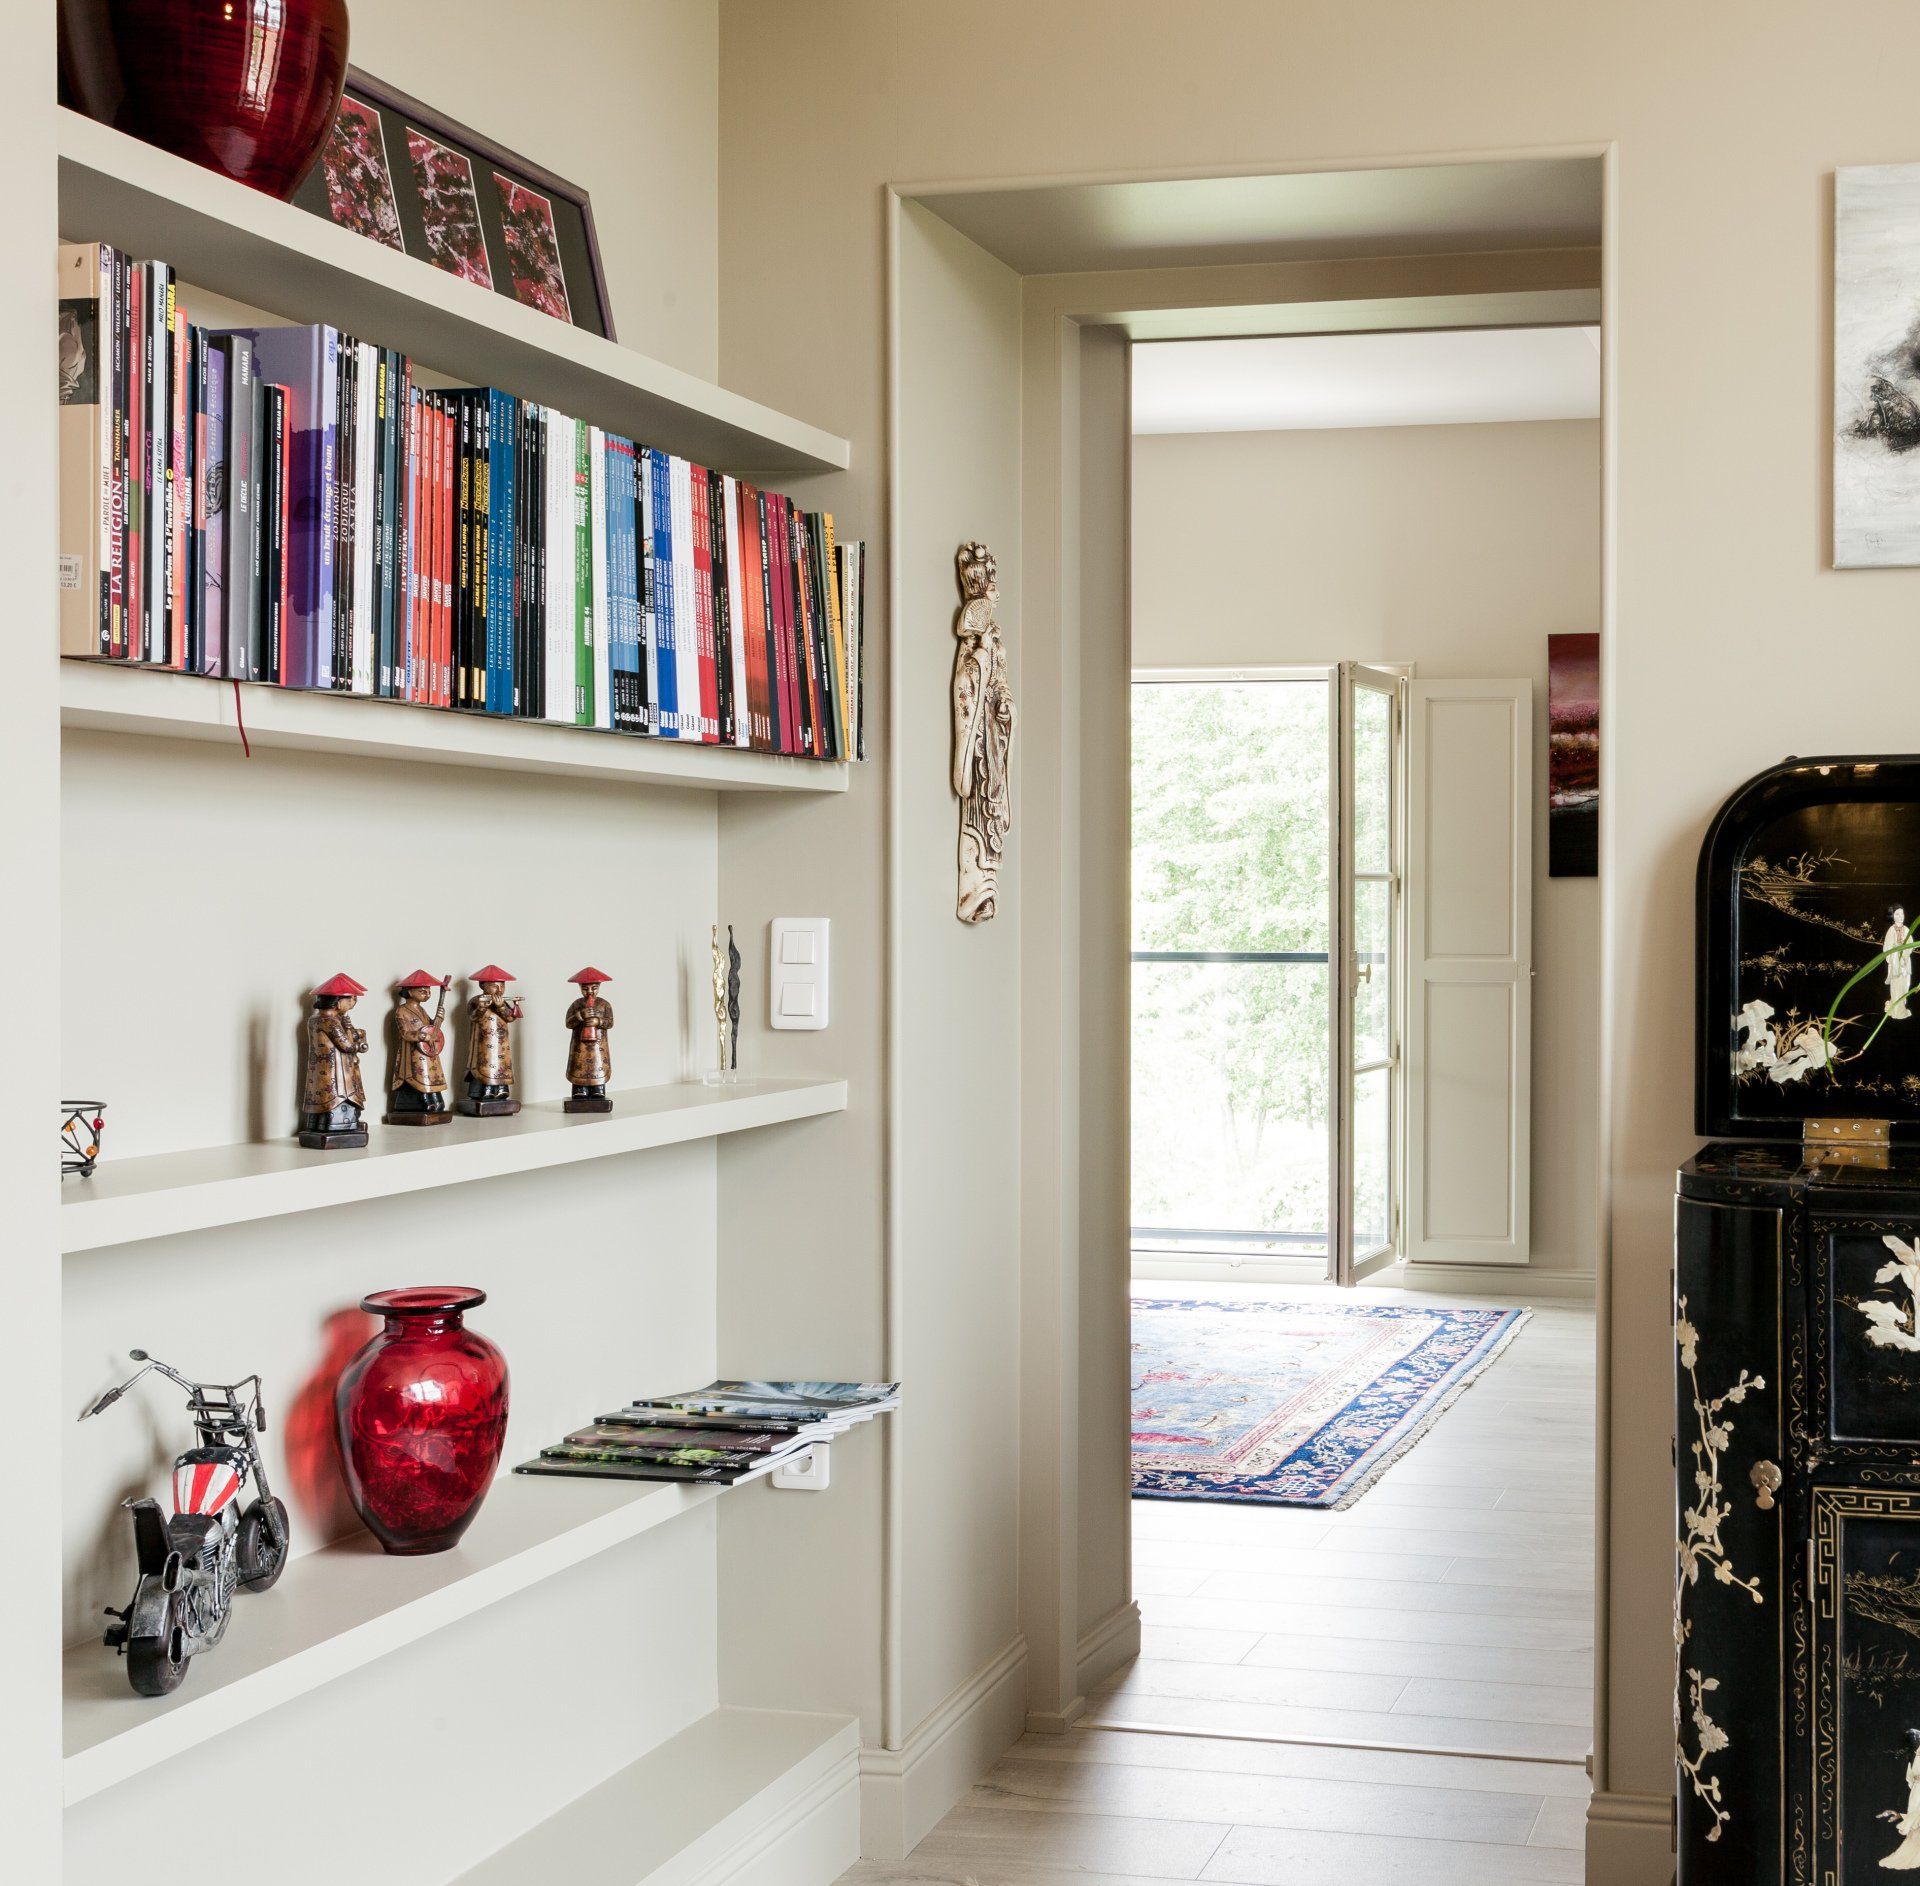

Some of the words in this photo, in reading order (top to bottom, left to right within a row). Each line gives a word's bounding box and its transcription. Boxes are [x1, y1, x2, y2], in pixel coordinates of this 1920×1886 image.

[167, 284, 175, 333] MANARA
[327, 342, 335, 365] zep
[324, 445, 332, 471] beau
[325, 472, 332, 482] et
[240, 505, 247, 513] LE
[324, 483, 332, 523] étrange
[111, 482, 122, 570] RELIGION
[166, 539, 172, 554] de
[324, 552, 331, 566] un
[112, 576, 122, 595] LA
[402, 578, 407, 592] LE
[166, 598, 172, 610] Le
[584, 606, 589, 617] 44
